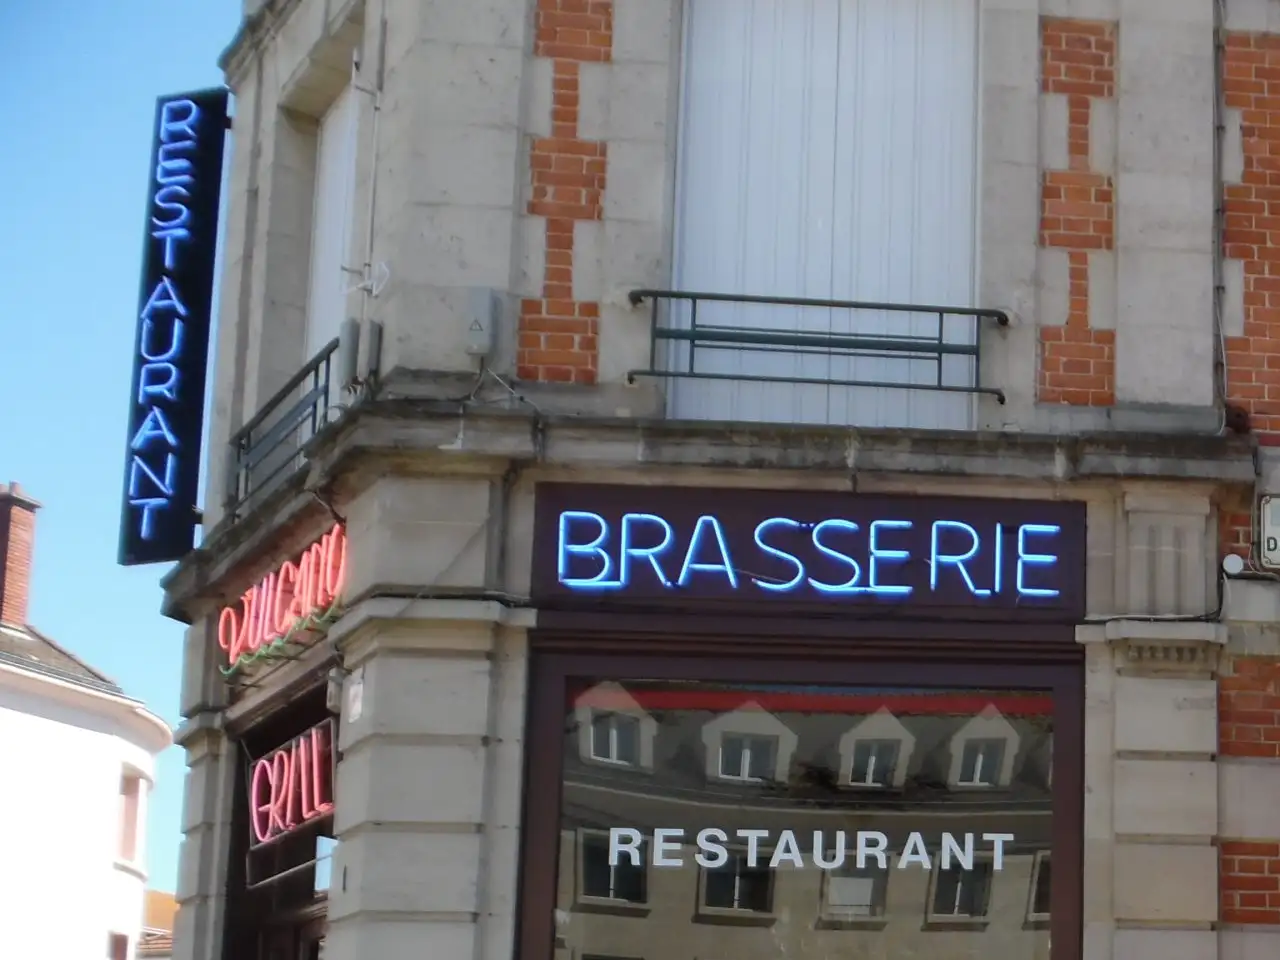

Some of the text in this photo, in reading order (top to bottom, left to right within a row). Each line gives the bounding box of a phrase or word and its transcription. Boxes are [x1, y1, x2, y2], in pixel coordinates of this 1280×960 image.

[128, 98, 199, 541] RESTAURANT
[218, 521, 348, 664] VULCANO
[557, 510, 1061, 596] BRASSERIE
[251, 727, 336, 842] GRILL
[608, 827, 1014, 871] RESTAURANT
